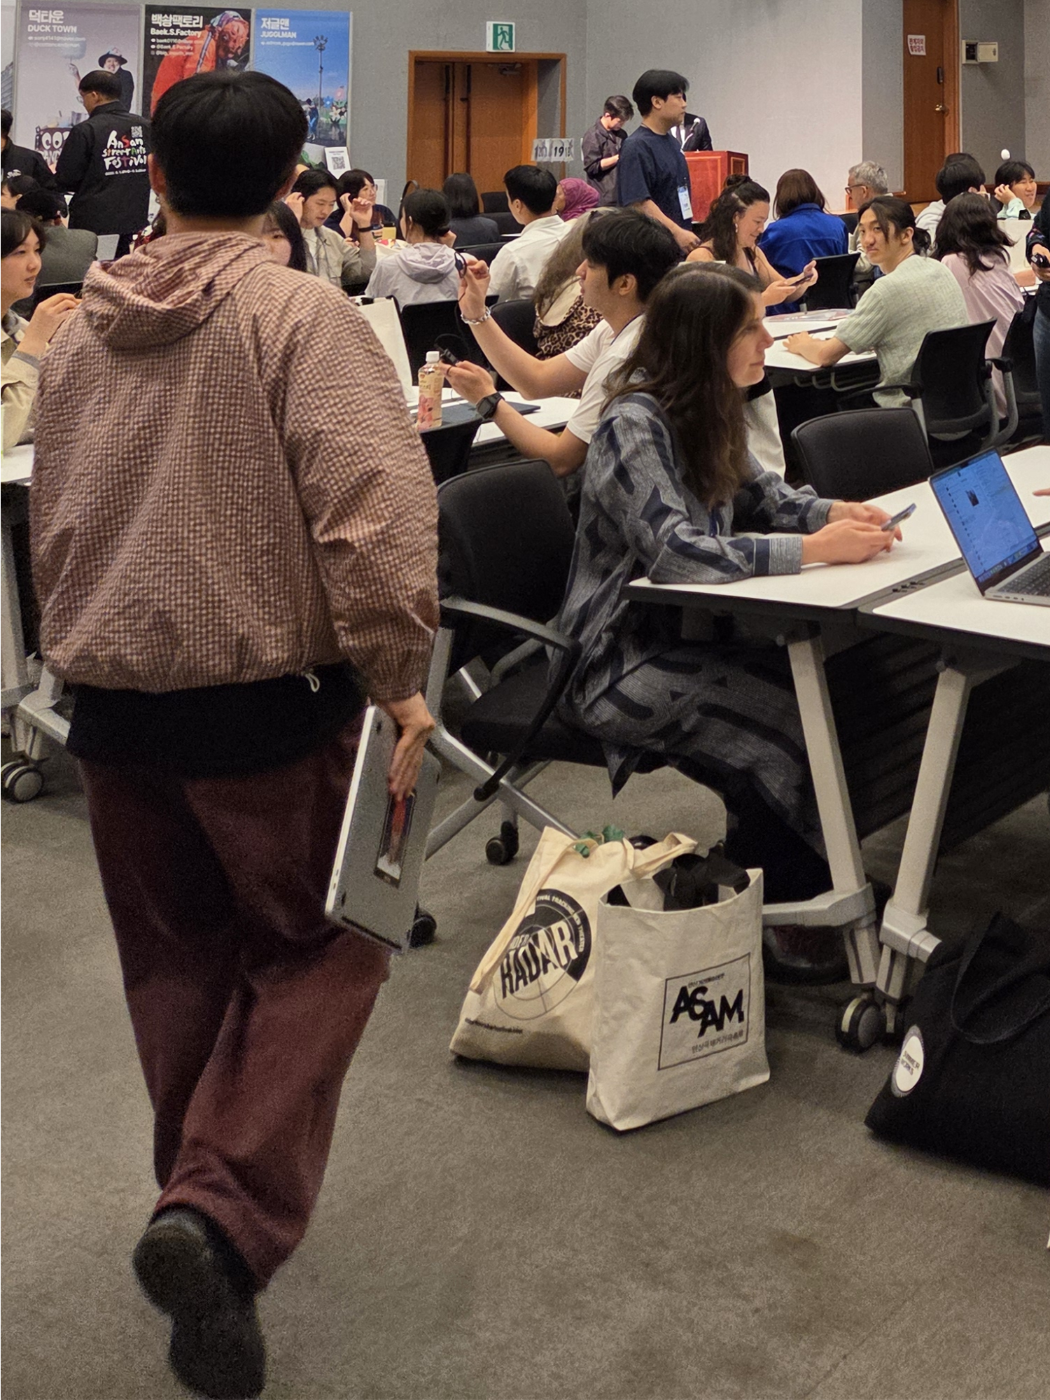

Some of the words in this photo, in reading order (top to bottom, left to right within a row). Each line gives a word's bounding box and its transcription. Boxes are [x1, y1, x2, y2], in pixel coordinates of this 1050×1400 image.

[28, 9, 64, 24] 덕타운
[261, 17, 290, 30] 저글맨
[27, 24, 51, 33] DUCK
[52, 25, 77, 33] TOWN
[501, 920, 578, 1000] RADAR
[669, 986, 745, 1038] ASAM
